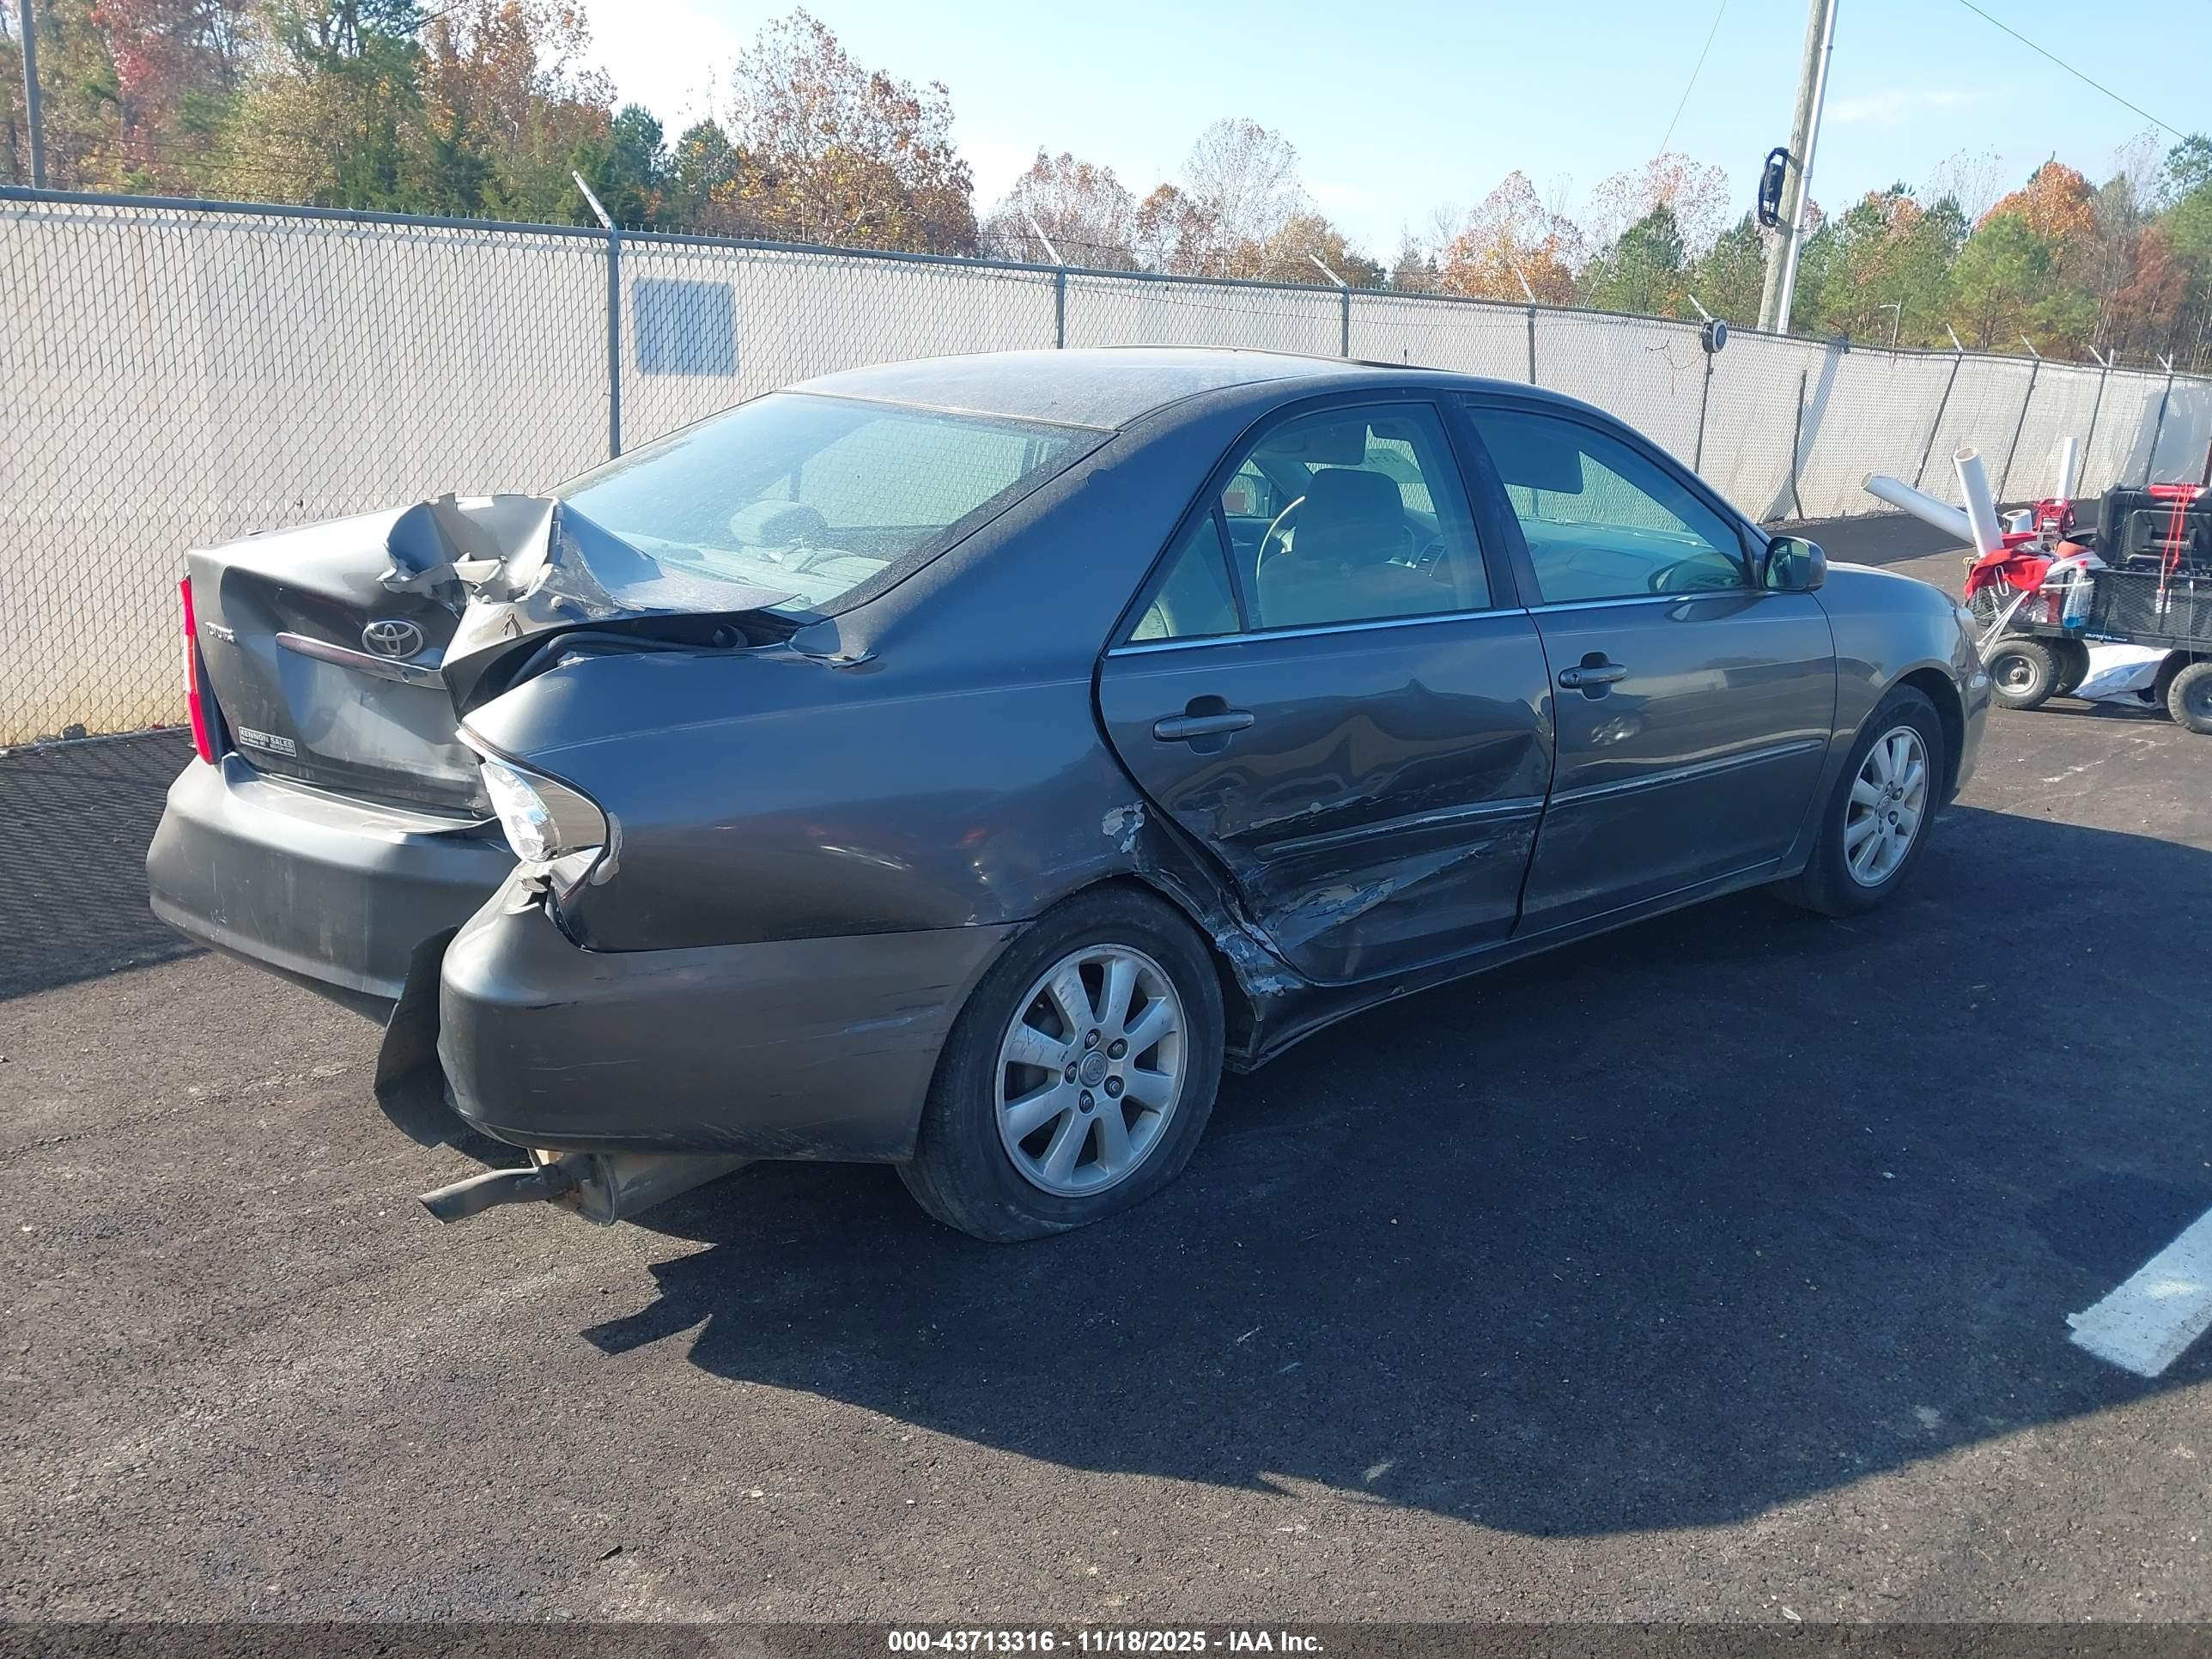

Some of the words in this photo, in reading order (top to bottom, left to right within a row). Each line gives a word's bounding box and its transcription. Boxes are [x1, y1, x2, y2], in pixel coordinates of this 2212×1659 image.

[205, 622, 234, 642] TOYOTA
[240, 729, 269, 743] KENNON
[270, 737, 293, 749] SALES
